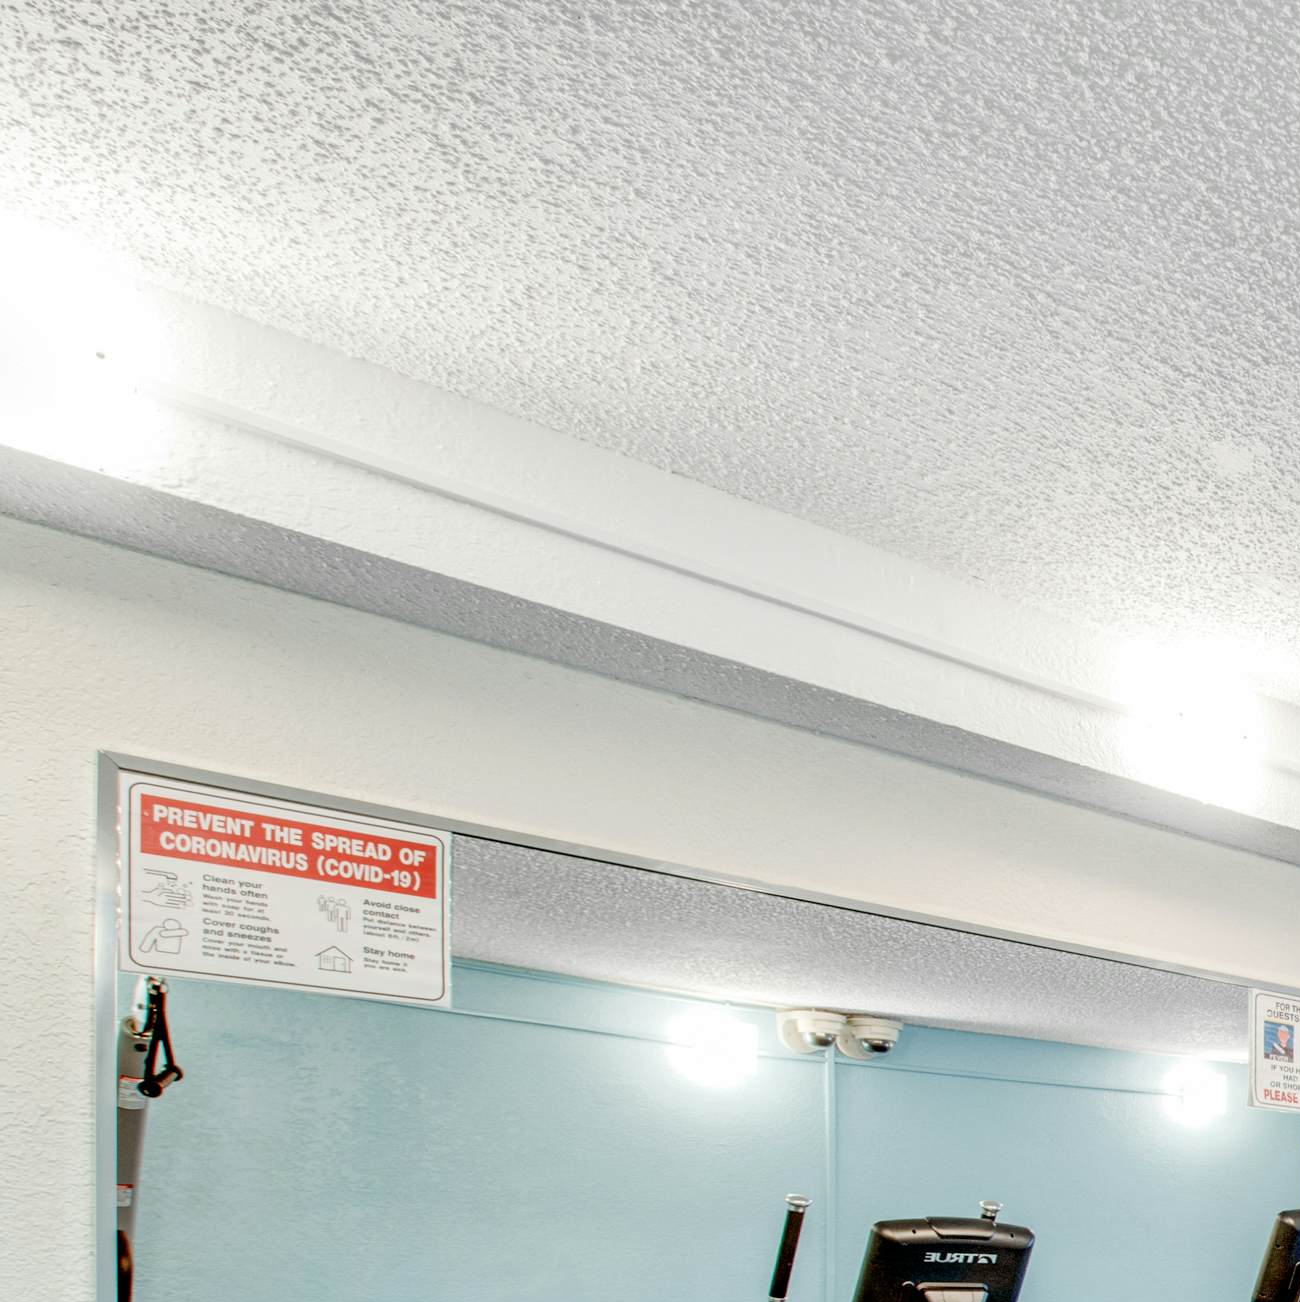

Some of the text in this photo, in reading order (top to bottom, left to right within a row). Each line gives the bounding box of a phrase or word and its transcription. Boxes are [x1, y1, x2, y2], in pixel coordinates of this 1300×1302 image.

[152, 804, 426, 867] PREVENT THE SPREAD OF
[159, 831, 421, 892] CORONAVIRUS (COVID-19)
[202, 873, 263, 890] Clean your
[202, 884, 268, 899] hands often
[363, 899, 421, 914] Avoid close
[363, 909, 400, 919] contact
[202, 917, 280, 935] Cover coughs
[202, 928, 272, 943] and sneezes
[363, 946, 415, 960] Stay home
[1275, 1002, 1290, 1011] FOR
[1280, 1065, 1294, 1073] YOU
[1263, 1087, 1299, 1103] PLEASE
